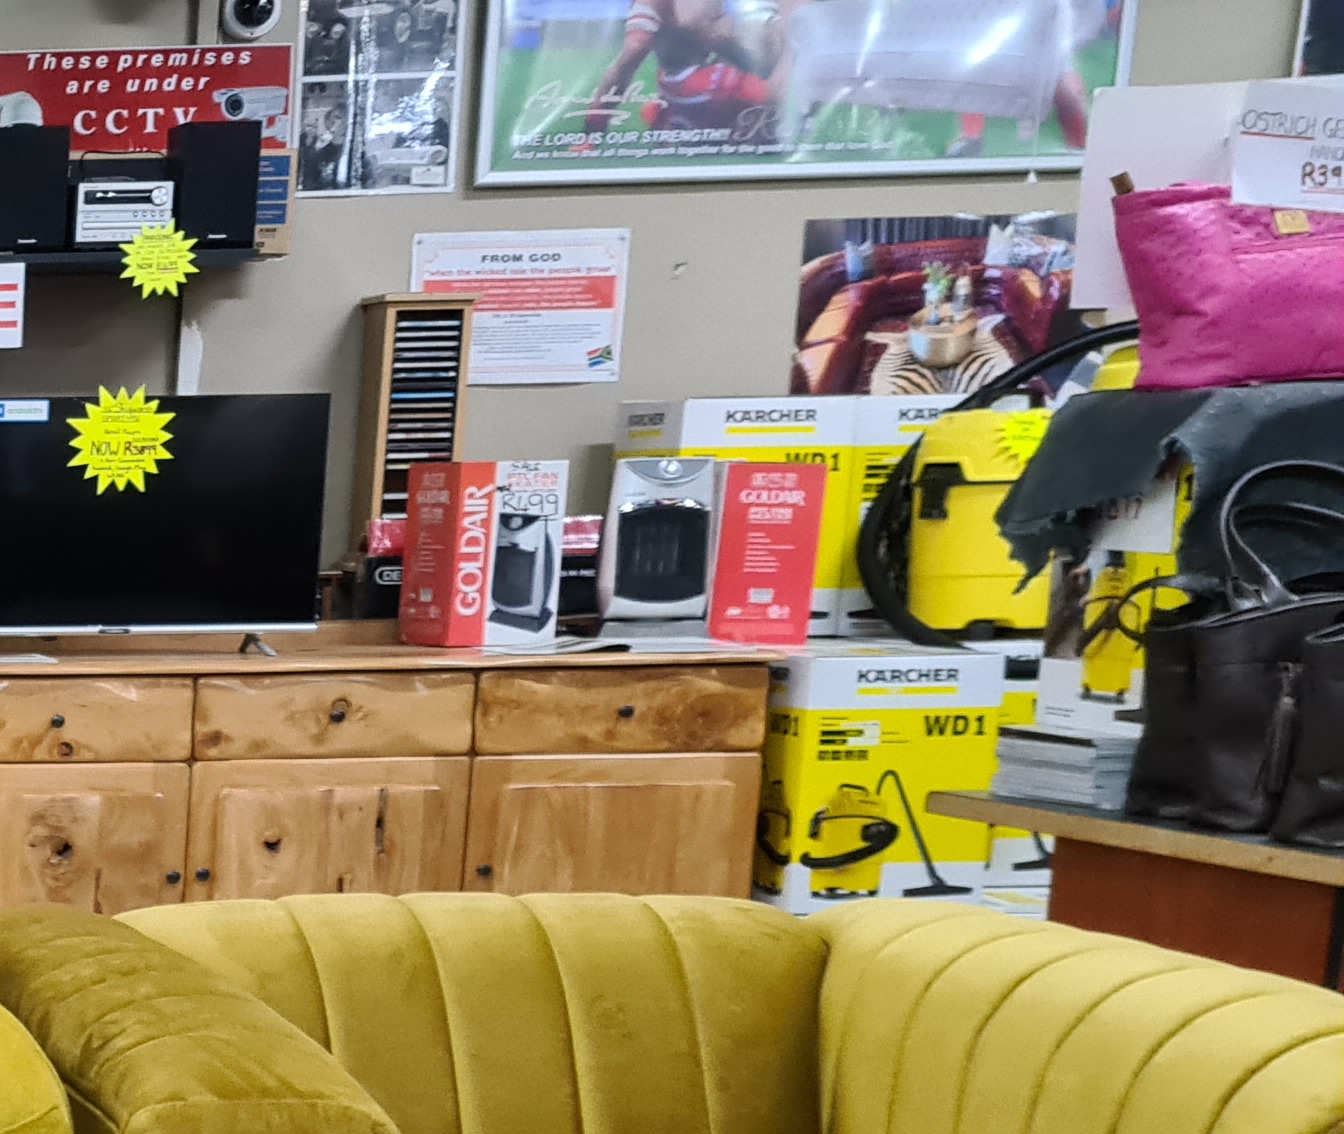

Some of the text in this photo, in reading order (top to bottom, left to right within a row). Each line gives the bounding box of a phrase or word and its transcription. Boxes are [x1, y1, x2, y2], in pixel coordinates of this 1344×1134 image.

[26, 50, 253, 72] These premises
[65, 74, 211, 94] are under
[73, 106, 198, 135] CCTV
[1241, 109, 1317, 136] OSTRICH
[544, 132, 586, 147] LORD
[588, 131, 604, 145] IS
[606, 131, 639, 145] OUR
[481, 253, 562, 263] FROM GOD
[456, 483, 496, 617] GOLDAIR
[922, 714, 987, 737] WD1
